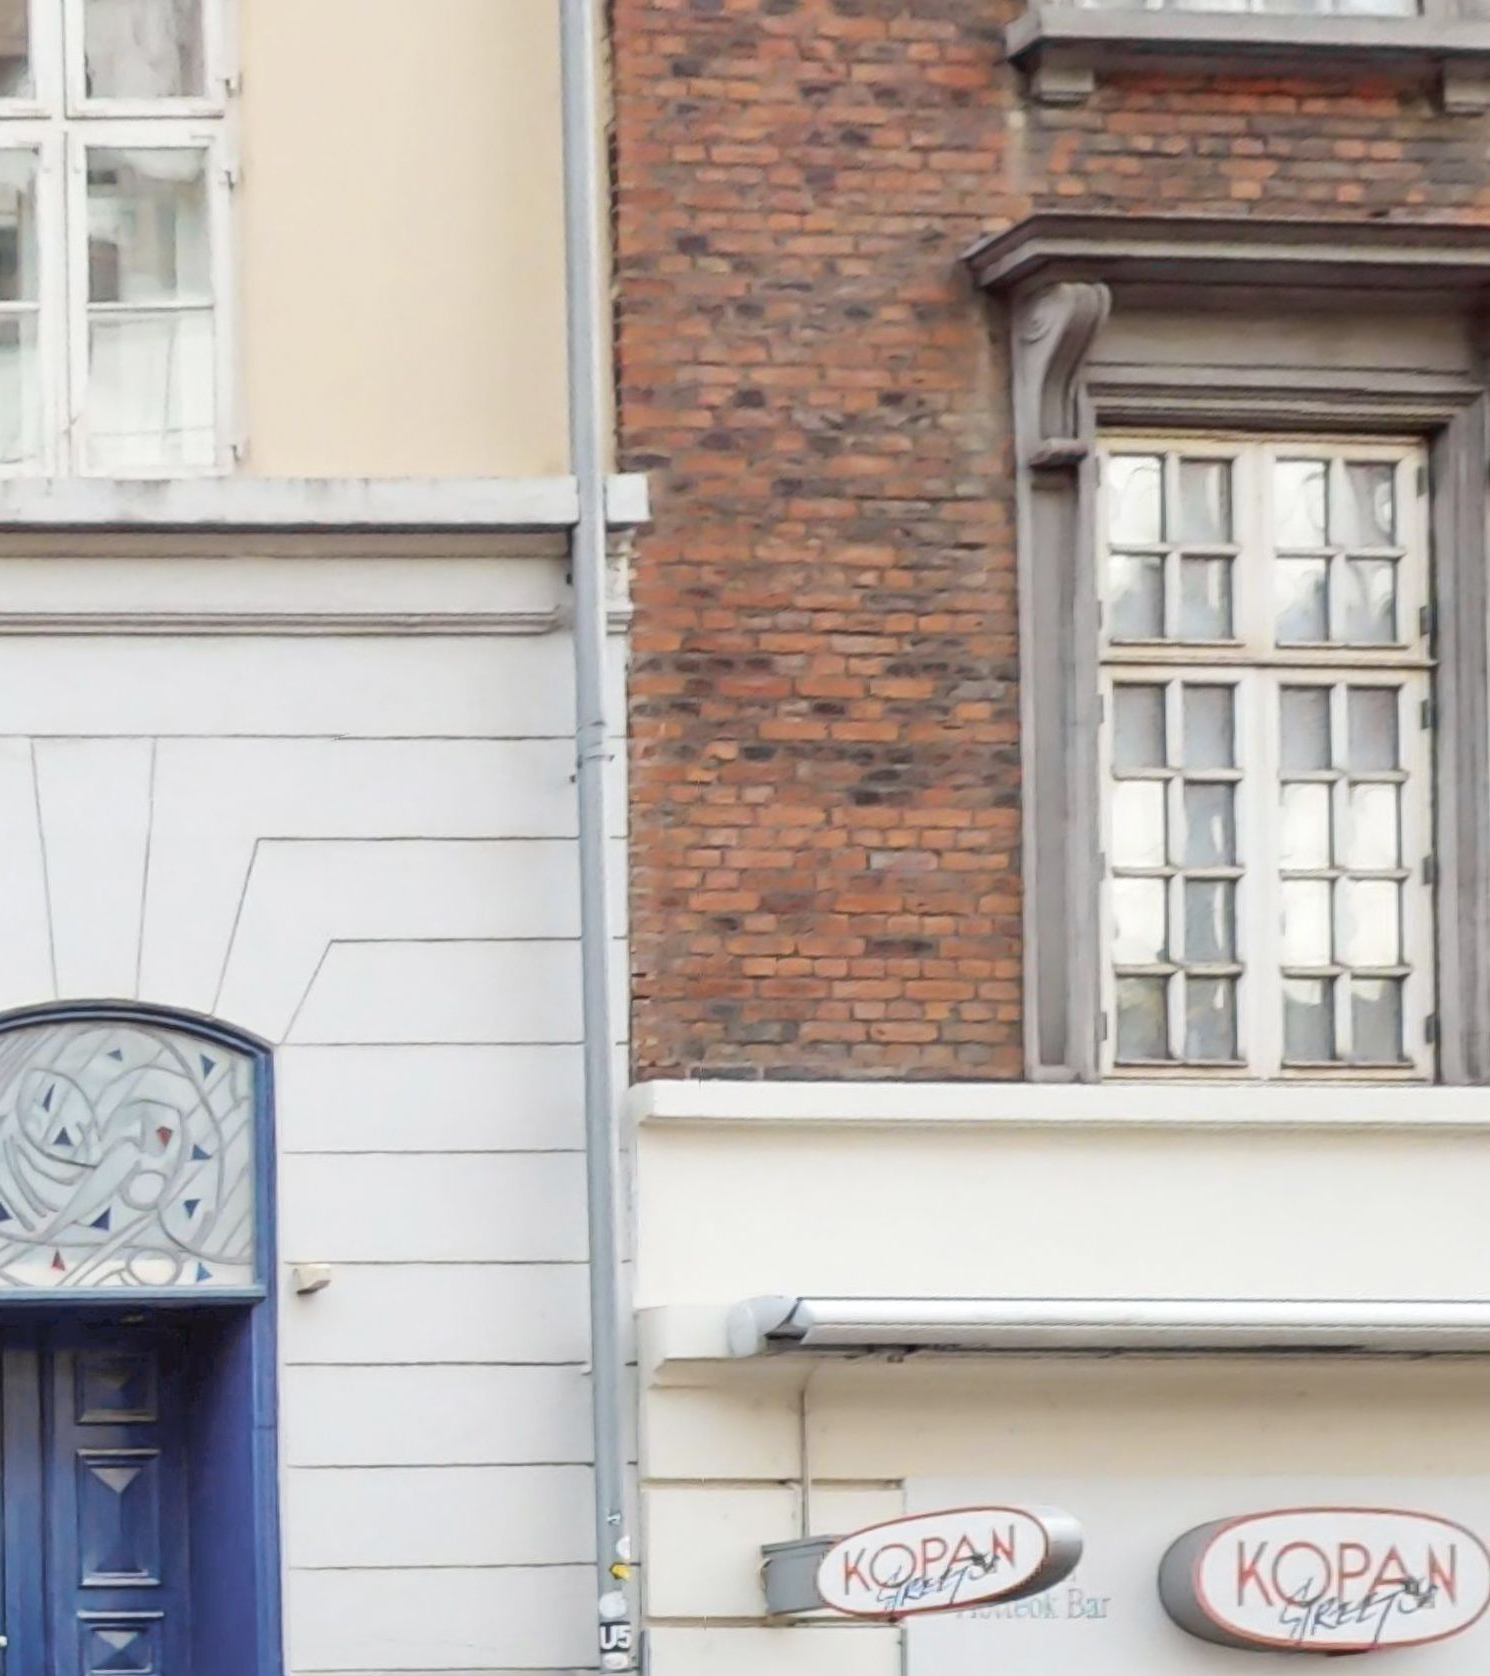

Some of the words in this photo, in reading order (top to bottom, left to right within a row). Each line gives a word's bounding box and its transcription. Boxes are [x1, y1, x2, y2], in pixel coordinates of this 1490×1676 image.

[843, 1525, 1016, 1595] KOPAN
[1237, 1540, 1457, 1607] KOPAN
[1068, 1589, 1112, 1620] Bar
